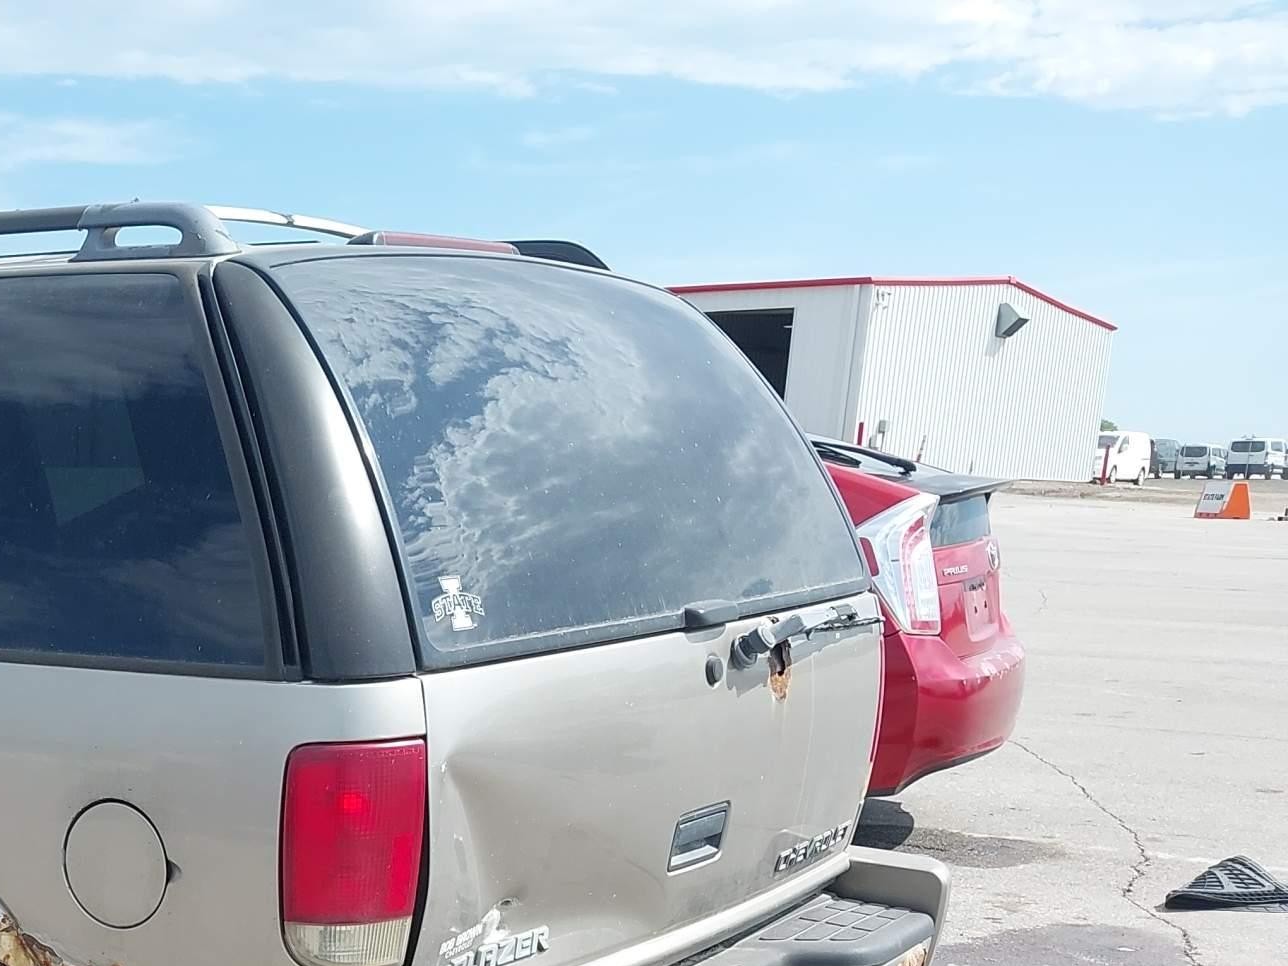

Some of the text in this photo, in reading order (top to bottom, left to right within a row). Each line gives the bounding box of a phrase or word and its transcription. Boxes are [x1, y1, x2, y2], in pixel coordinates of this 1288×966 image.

[943, 565, 968, 576] PRIUS
[432, 591, 485, 622] STATE
[774, 819, 852, 873] CHEVROLET
